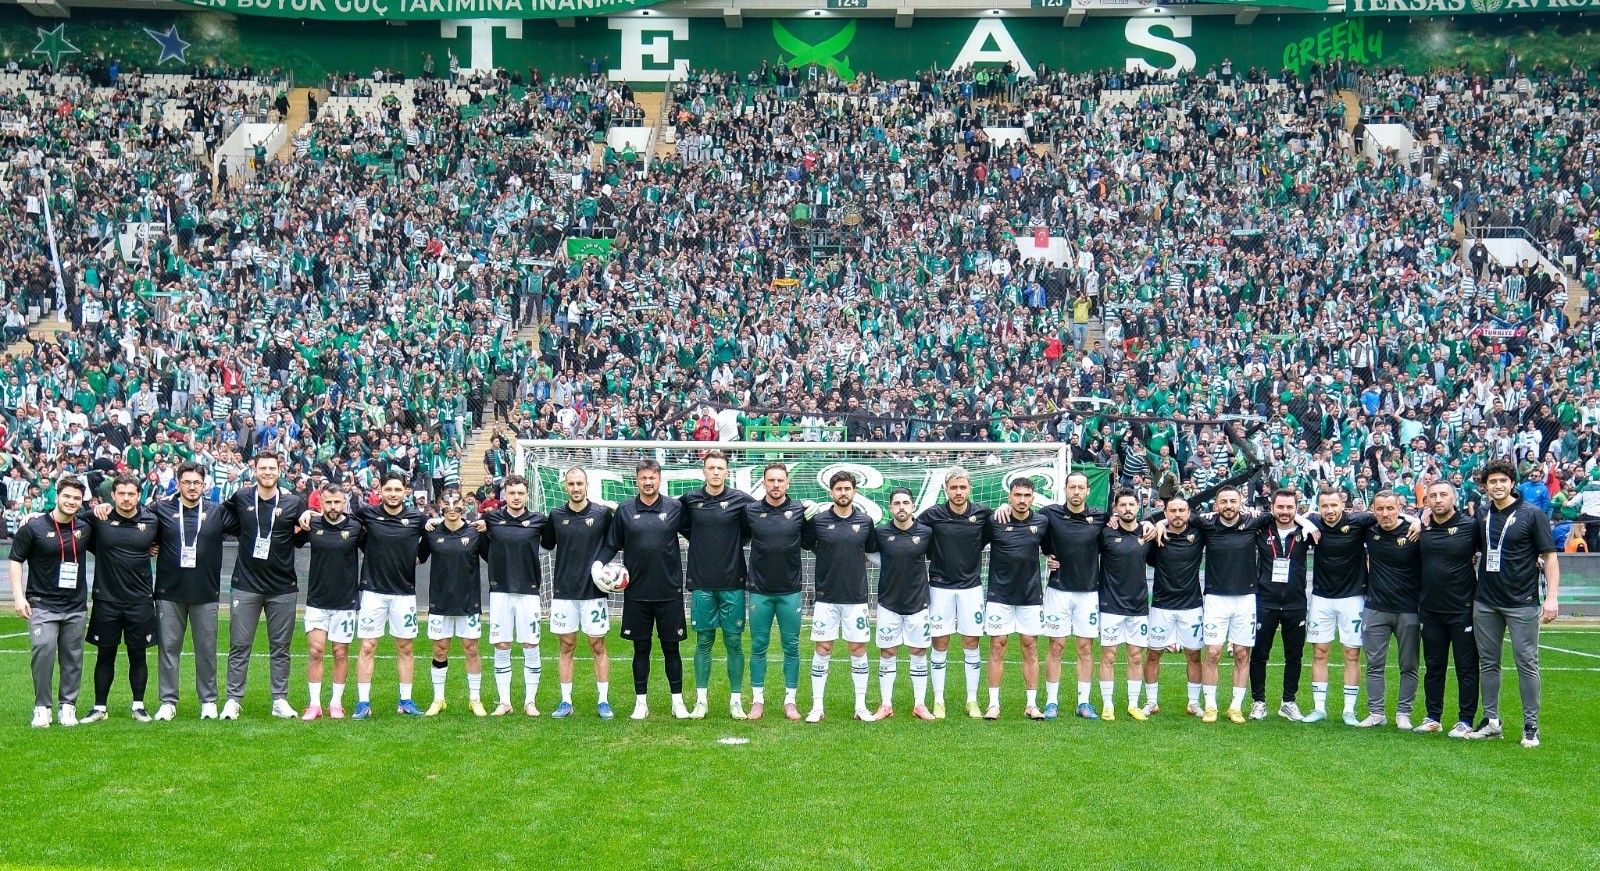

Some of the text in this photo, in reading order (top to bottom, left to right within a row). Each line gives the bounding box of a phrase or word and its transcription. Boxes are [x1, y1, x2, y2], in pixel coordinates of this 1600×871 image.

[1283, 16, 1365, 75] GREEN
[591, 608, 607, 623] 24
[1089, 612, 1097, 625] 5
[1140, 623, 1148, 636] 9
